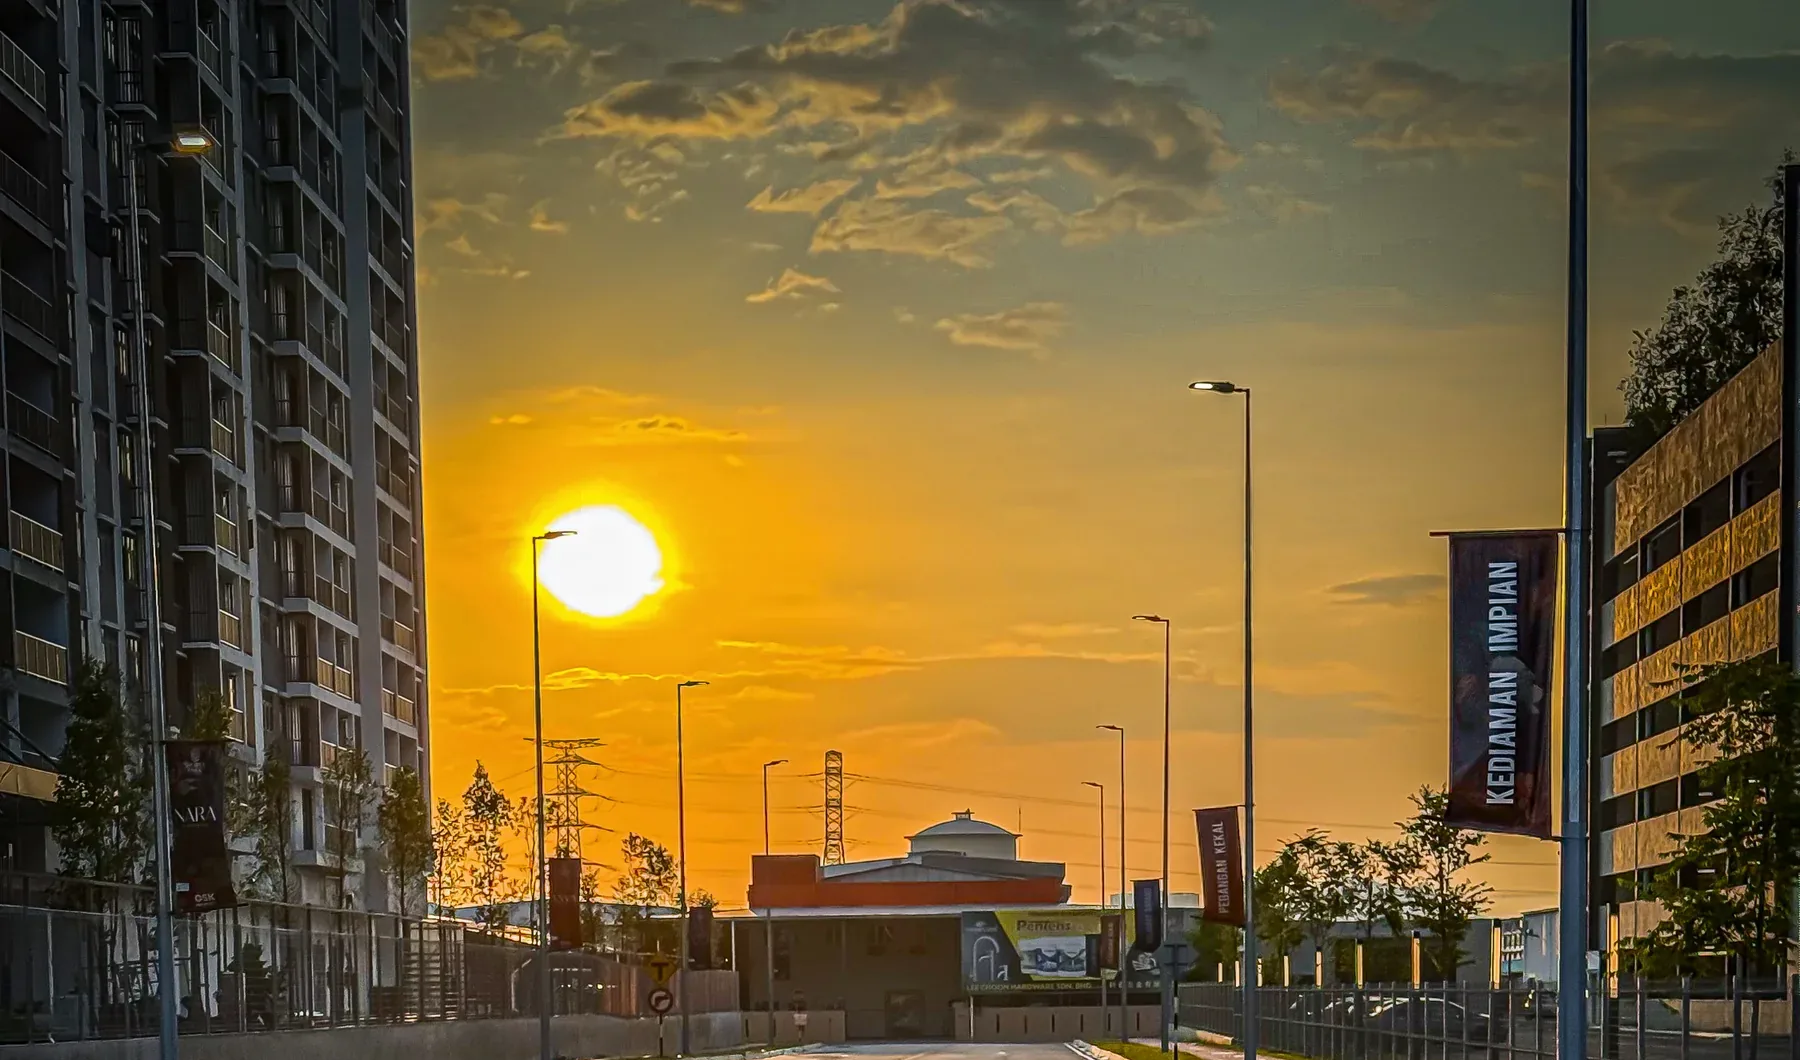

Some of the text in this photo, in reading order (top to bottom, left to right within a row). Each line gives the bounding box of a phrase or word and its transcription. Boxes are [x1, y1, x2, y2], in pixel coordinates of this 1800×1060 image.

[1485, 561, 1519, 805] KEDIAMAN IMPIAN
[174, 806, 217, 823] NARA
[1212, 821, 1227, 854] KEKAL
